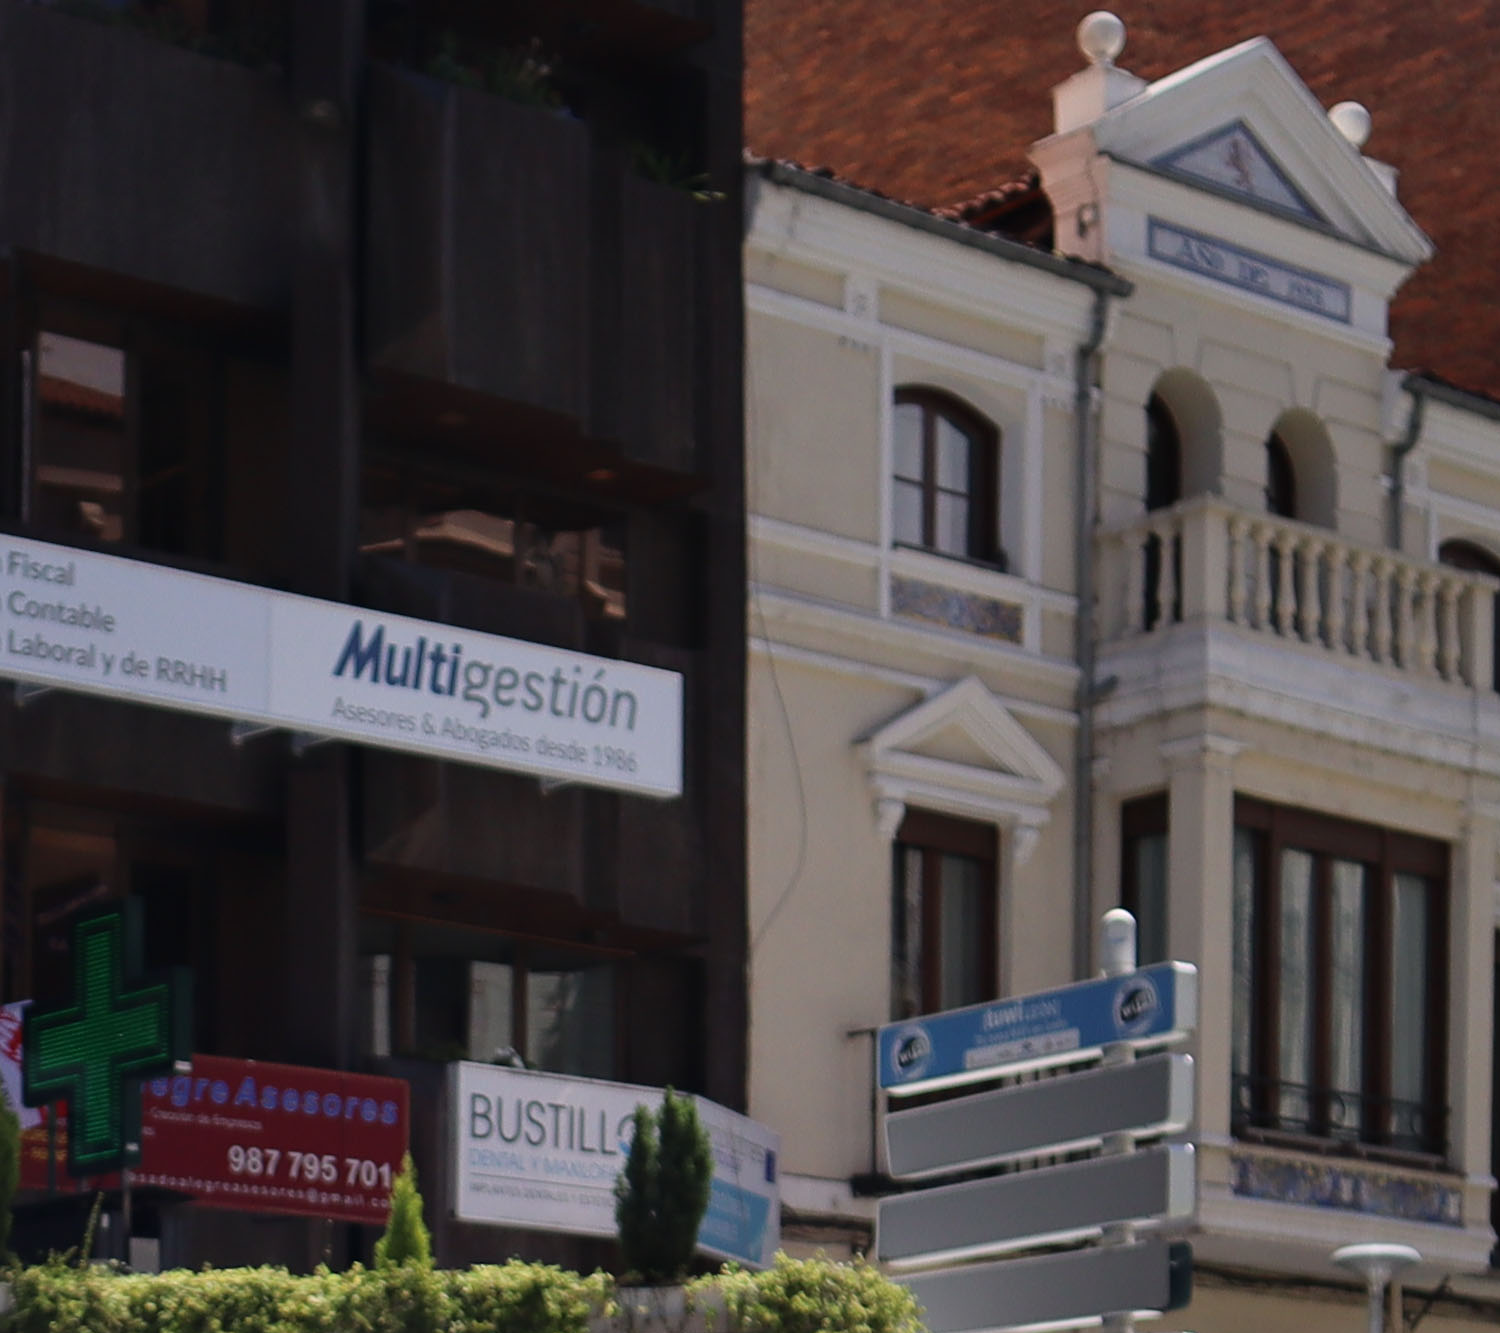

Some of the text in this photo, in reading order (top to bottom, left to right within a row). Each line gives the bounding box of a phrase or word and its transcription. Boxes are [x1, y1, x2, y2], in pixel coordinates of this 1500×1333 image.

[7, 551, 77, 586] Fiscal
[8, 590, 116, 633] Contable
[8, 630, 95, 669] Laboral
[102, 652, 113, 677] y
[120, 651, 149, 677] de
[156, 657, 227, 692] RRHH
[333, 619, 639, 731] Multigestión
[333, 698, 416, 734] Asesores
[423, 714, 437, 734] &
[233, 1076, 399, 1126] Asesores
[227, 1144, 392, 1190] 987 795 701
